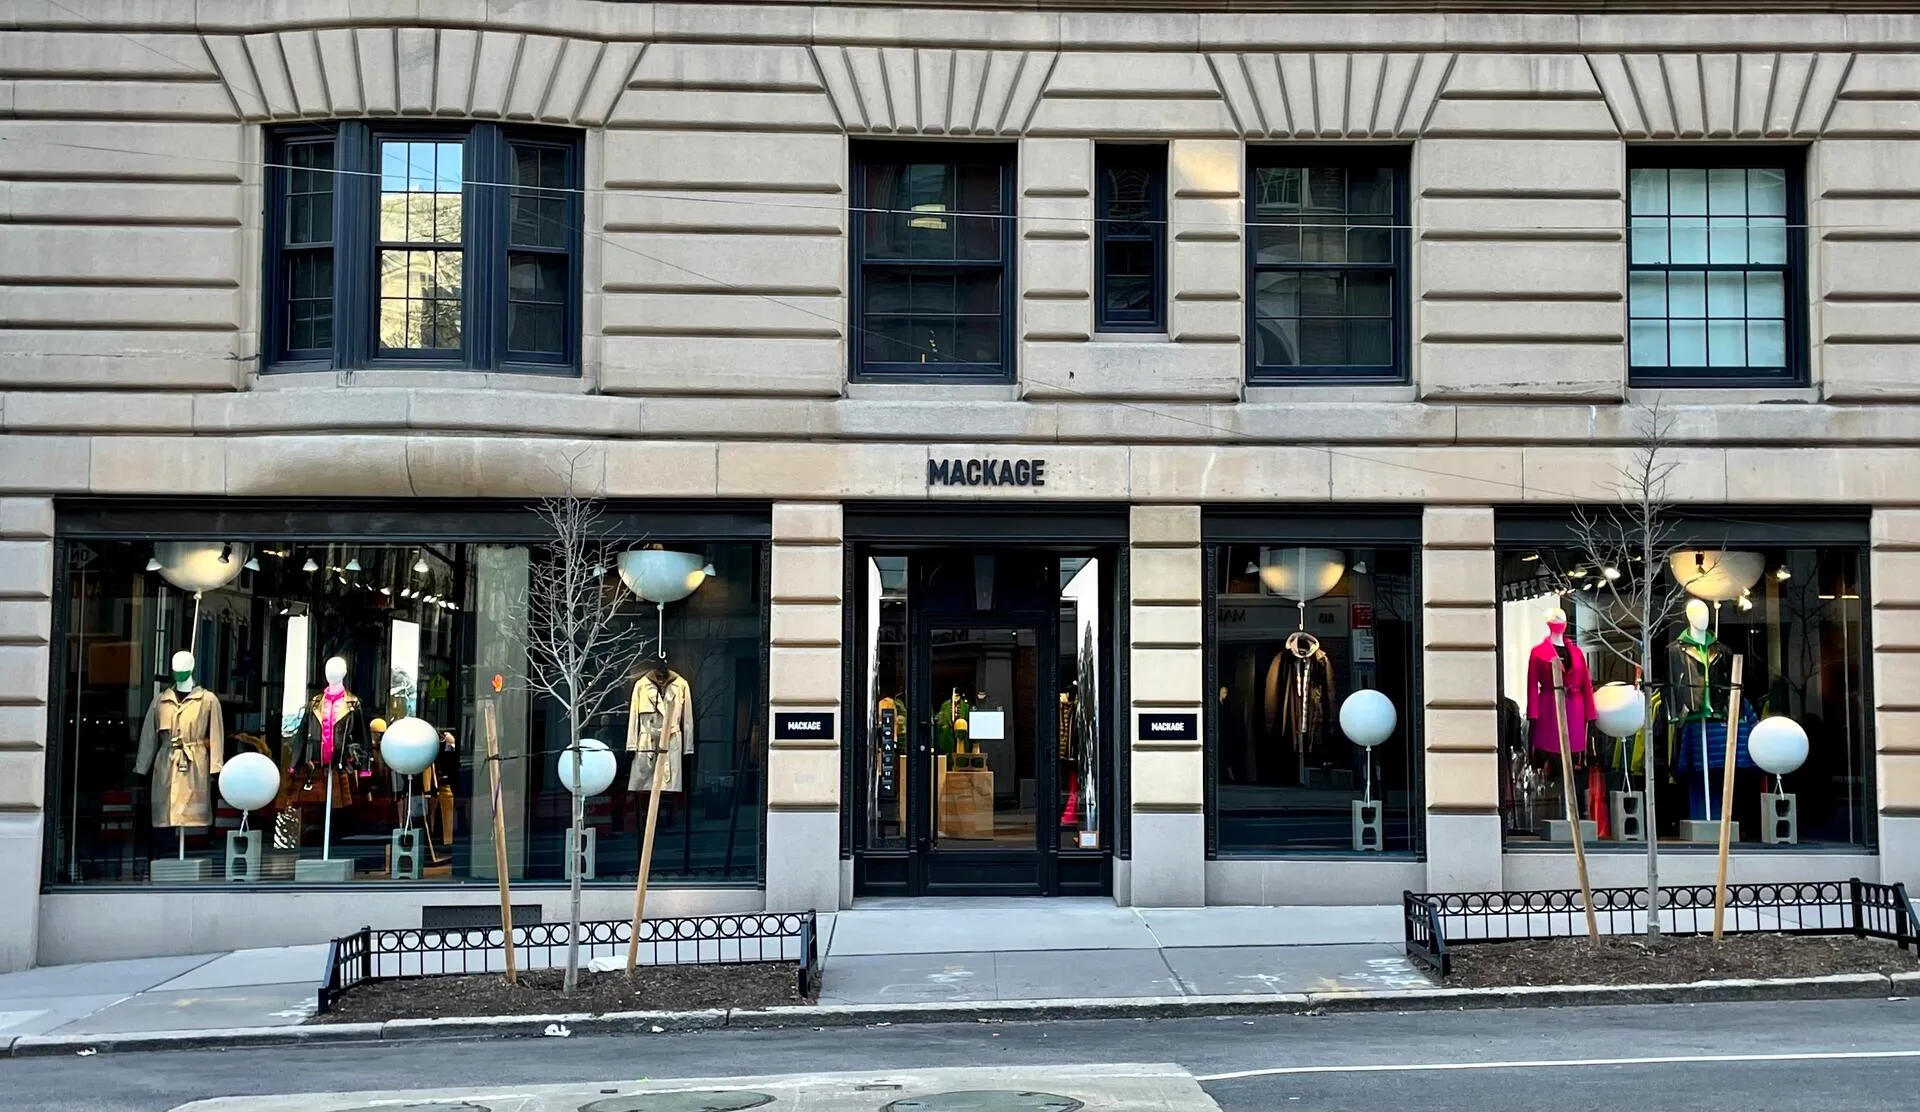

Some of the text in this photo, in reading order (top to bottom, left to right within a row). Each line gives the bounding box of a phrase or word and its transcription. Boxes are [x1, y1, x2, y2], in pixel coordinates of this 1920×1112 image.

[929, 459, 1045, 486] MACKAGE
[788, 721, 821, 731] MACKAGE
[1151, 722, 1184, 731] MACKAGE
